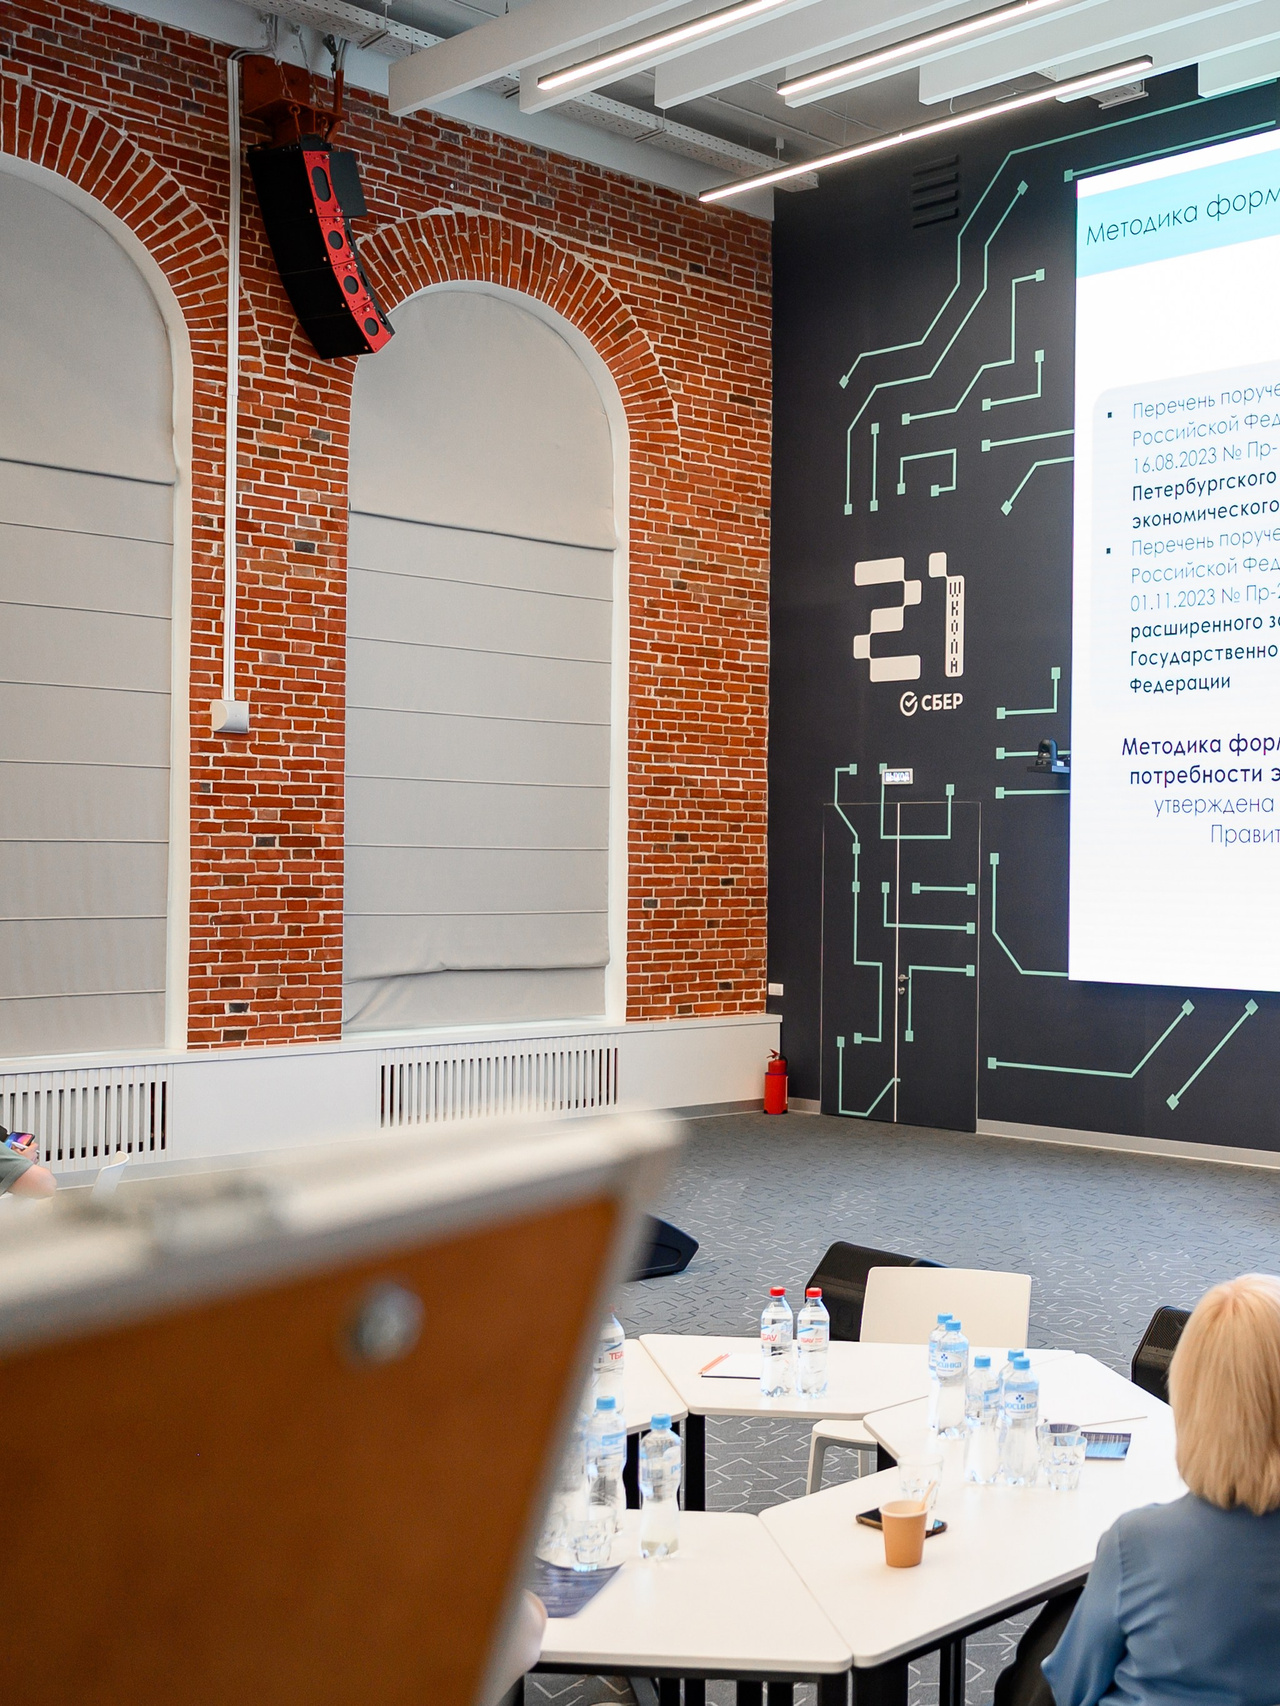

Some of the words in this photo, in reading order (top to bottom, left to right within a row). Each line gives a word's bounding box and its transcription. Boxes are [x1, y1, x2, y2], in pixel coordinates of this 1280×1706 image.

[1087, 205, 1197, 245] Методика
[1133, 395, 1215, 420] Перечень
[1133, 415, 1239, 447] Российской
[1133, 444, 1219, 475] 16.08.2023
[1133, 471, 1276, 501] Петербургского
[1133, 500, 1280, 529] экономического
[1132, 536, 1214, 558] Перечень
[1132, 557, 1237, 584] Российской
[1131, 588, 1215, 612] 01.11.2023
[949, 581, 962, 673] ШКОЛА
[1131, 617, 1263, 643] расширенного
[1130, 677, 1230, 695] Федерации
[921, 692, 964, 711] СБЕР
[1122, 738, 1221, 756] Методика
[1131, 765, 1262, 788] потребности
[1154, 798, 1274, 817] утверждена
